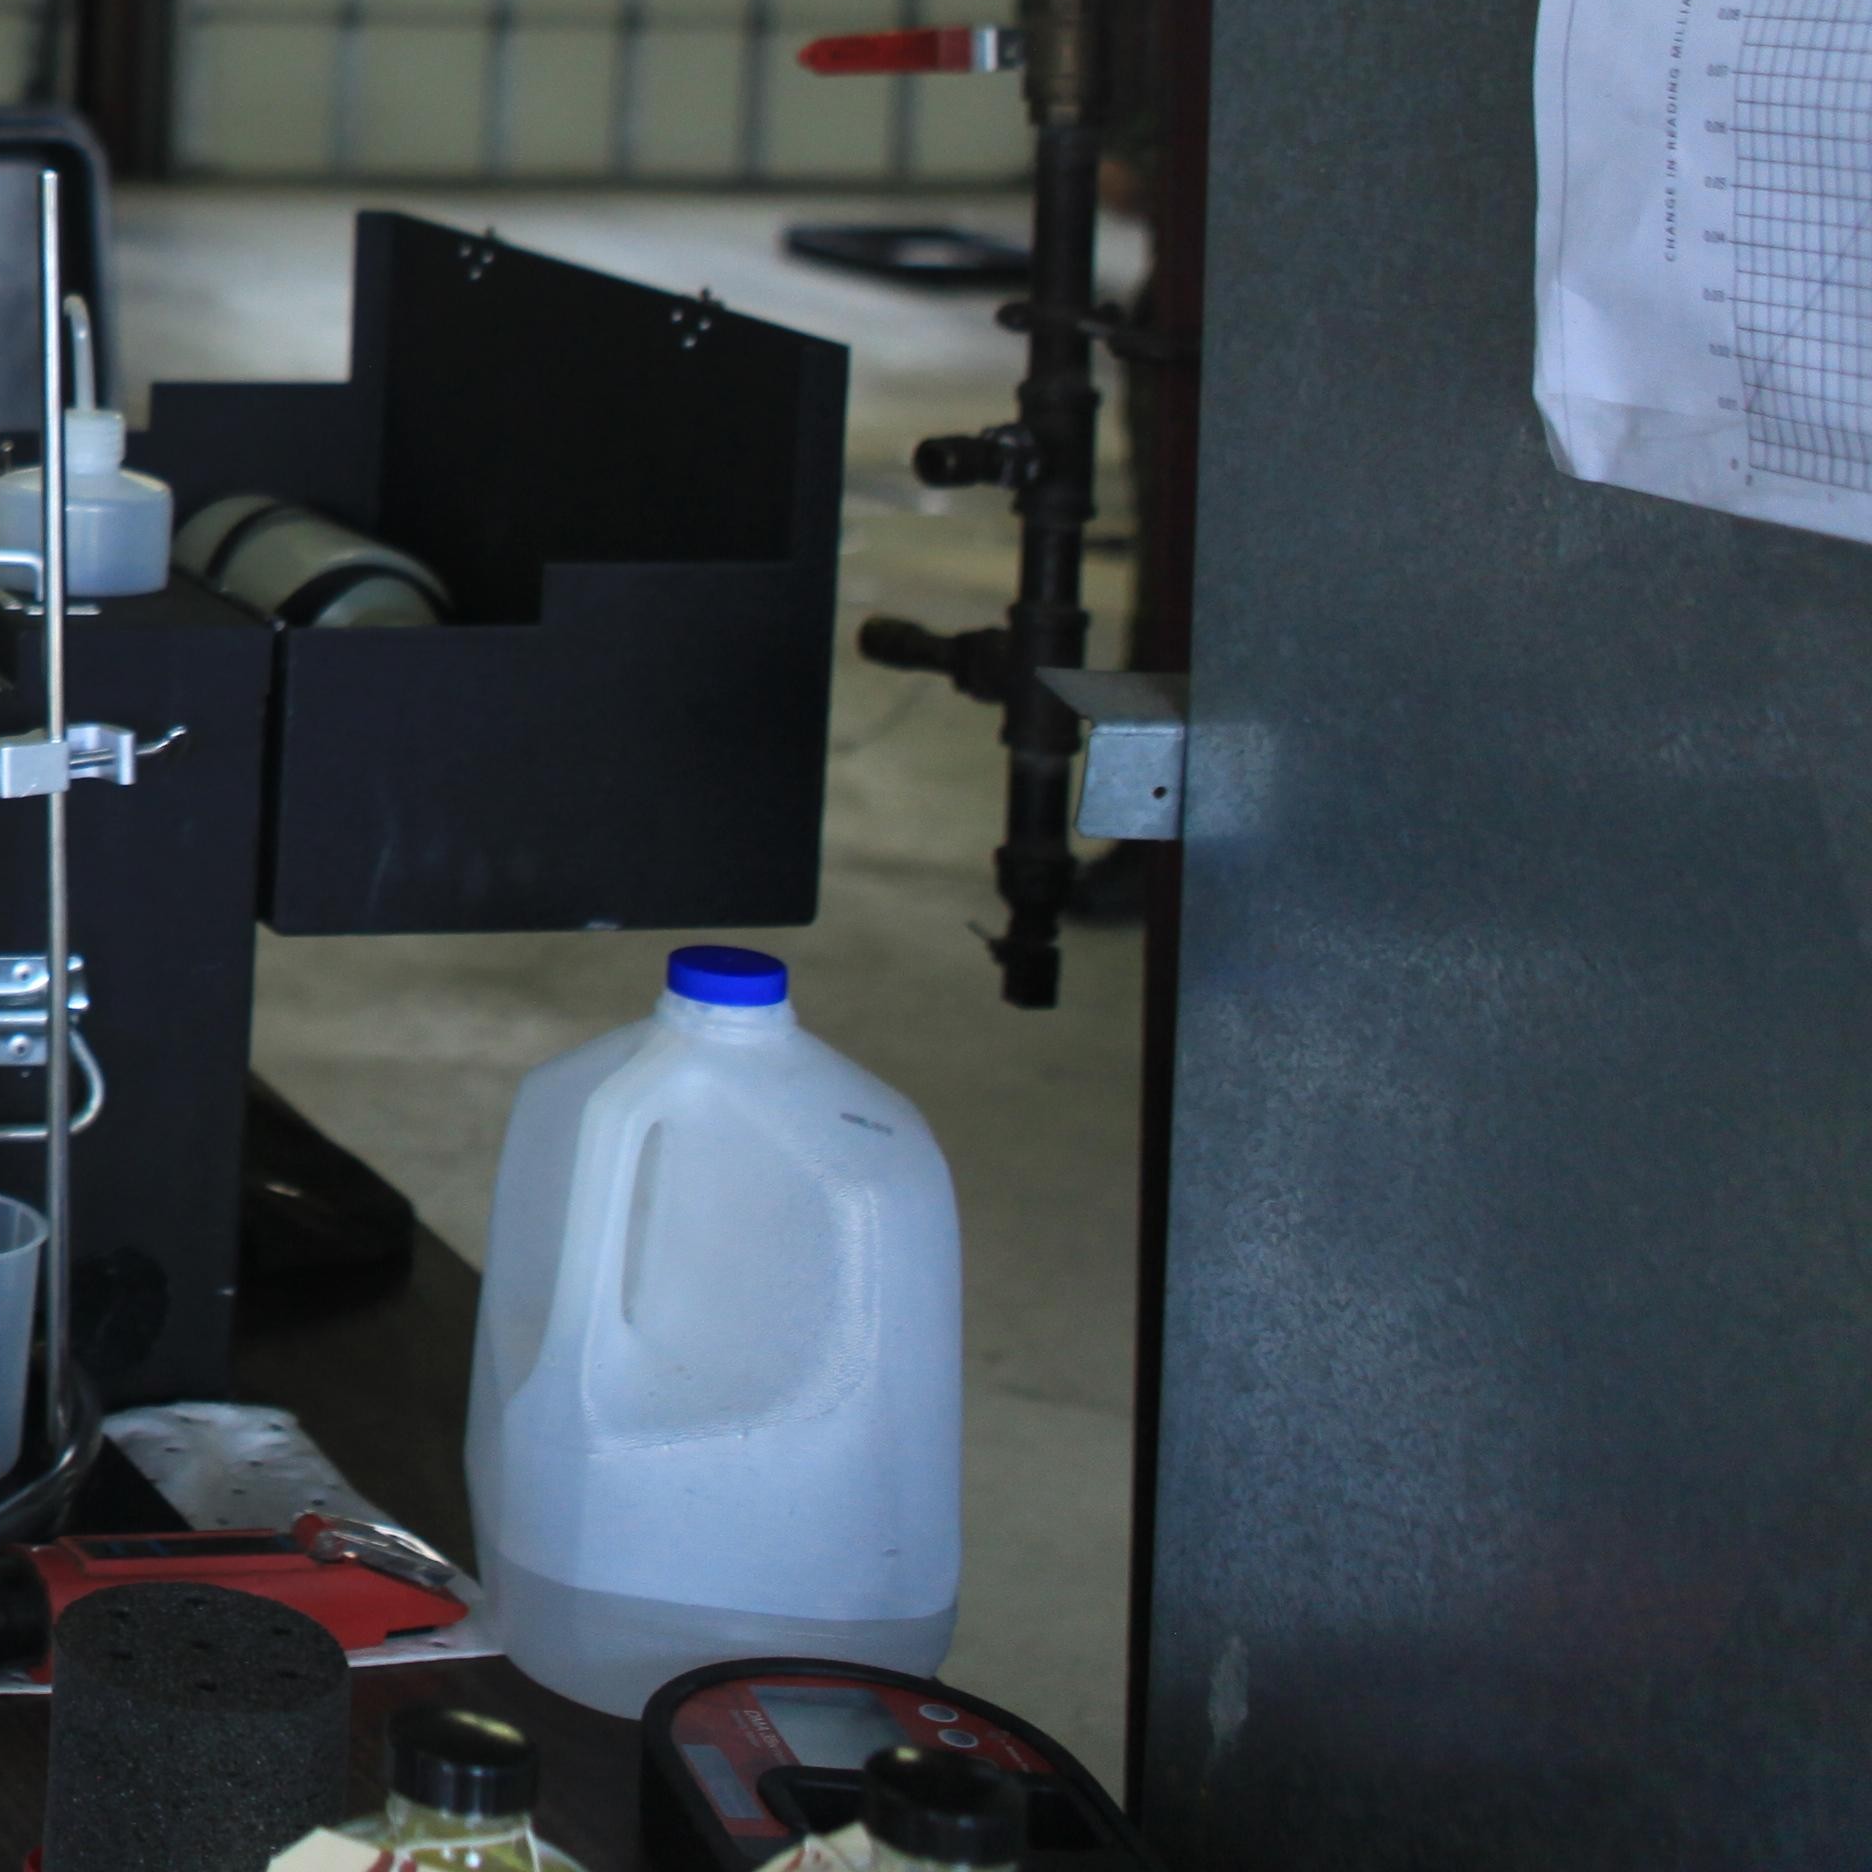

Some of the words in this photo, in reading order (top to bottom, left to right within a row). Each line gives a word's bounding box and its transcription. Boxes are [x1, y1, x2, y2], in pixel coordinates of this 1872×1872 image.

[1665, 67, 1680, 151] READING
[1665, 159, 1678, 179] IN
[1664, 185, 1677, 262] CHANGE
